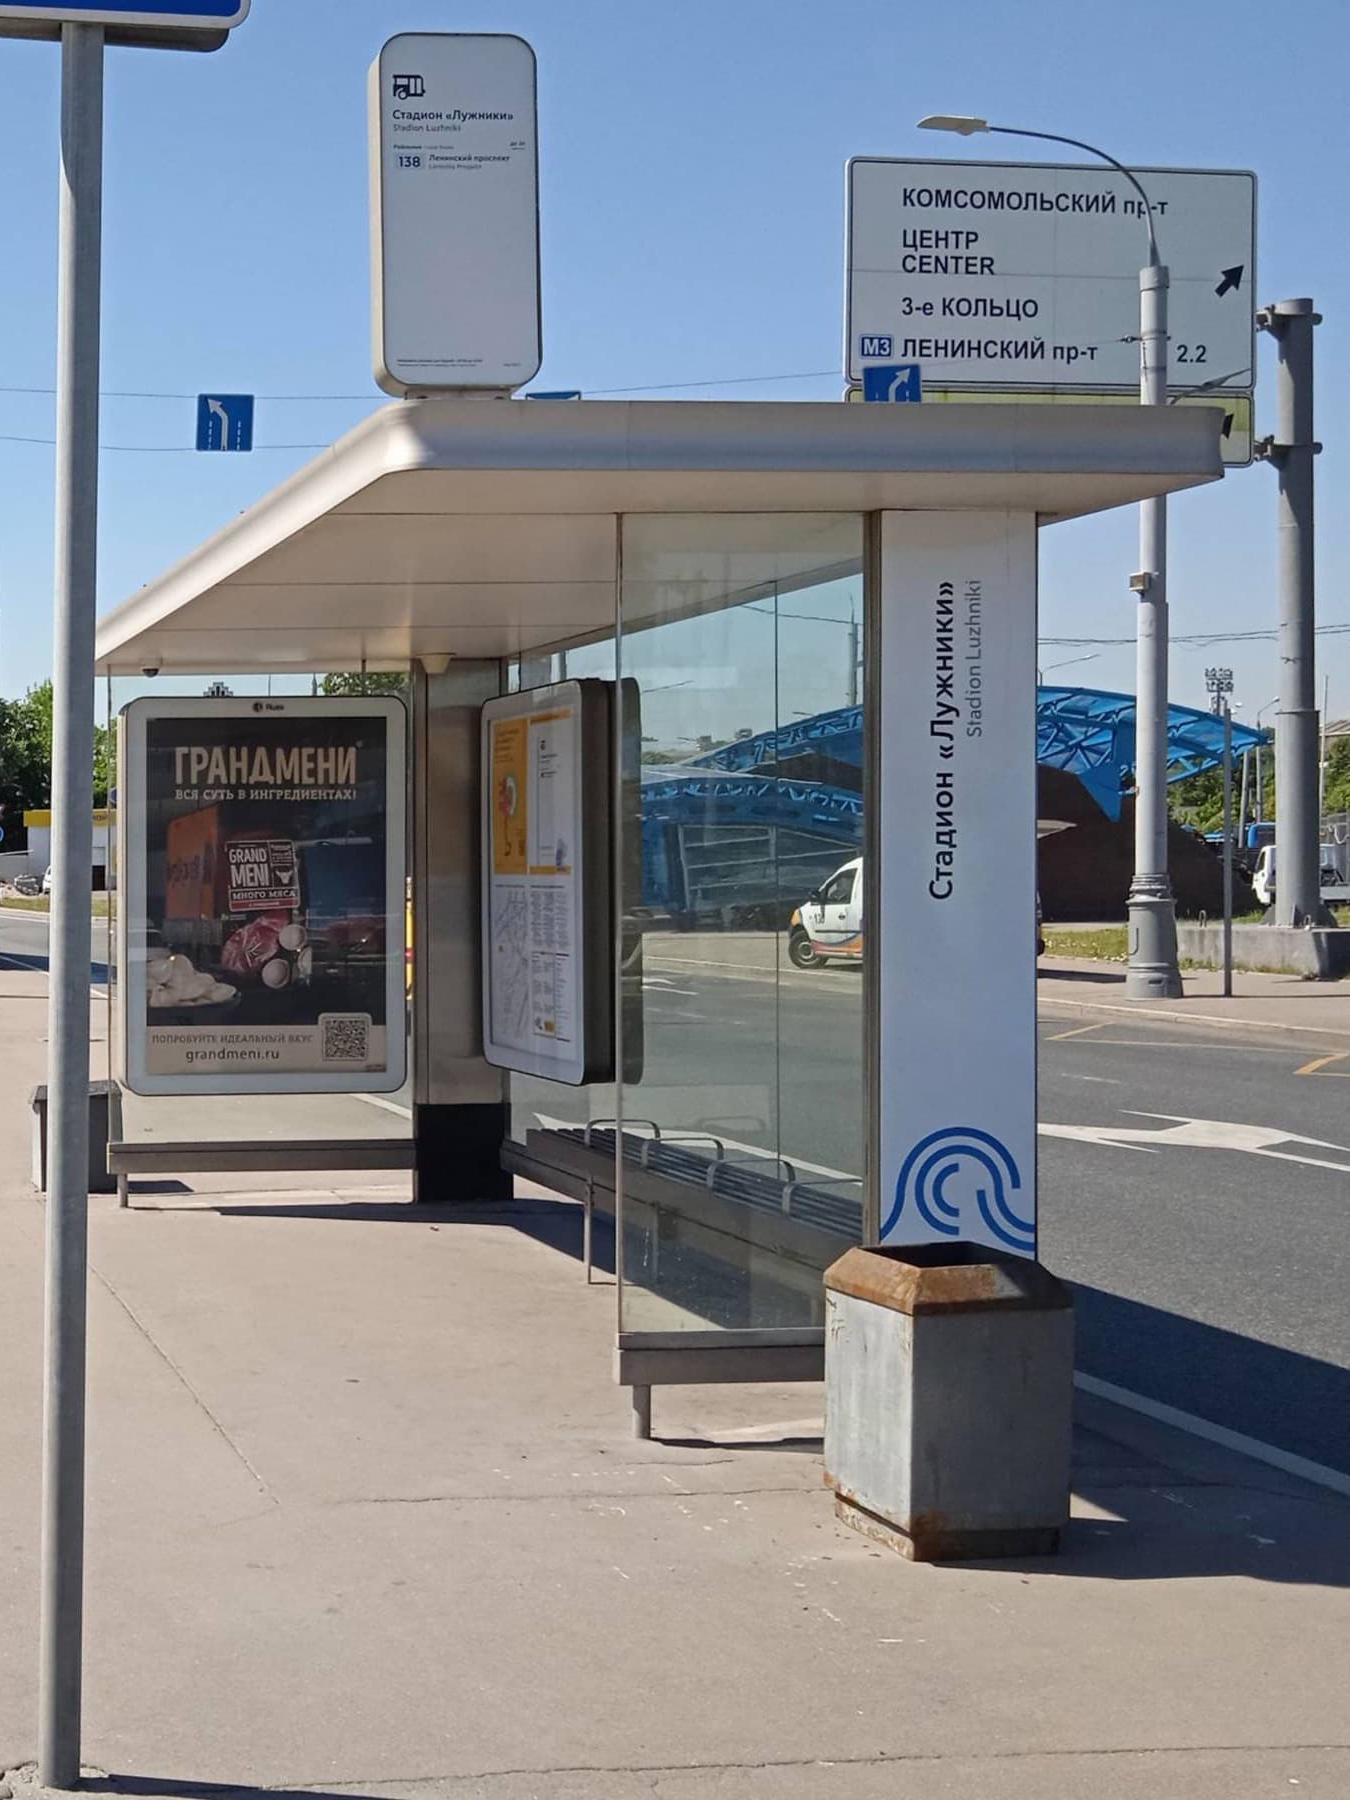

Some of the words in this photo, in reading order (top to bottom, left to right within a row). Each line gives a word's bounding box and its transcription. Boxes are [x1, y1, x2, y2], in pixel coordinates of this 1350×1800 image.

[392, 109, 443, 121] Стадион
[446, 109, 514, 123] «Лужники»
[398, 156, 421, 168] 138
[902, 187, 1117, 214] КОМСОМОЛЬСКИЙ
[902, 228, 979, 252] ЦЕНТР
[901, 253, 996, 276] CENTER
[901, 296, 935, 316] 3-е
[941, 297, 1040, 322] КОЛЬЦО
[862, 337, 891, 356] М3
[901, 335, 1046, 360] ЛЕНИНСКИЙ
[1052, 345, 1099, 365] пр-т
[1176, 343, 1208, 363] 2.2
[963, 579, 983, 660] Luzhniki
[930, 581, 960, 761] «Лужники»
[966, 665, 983, 738] Stadion
[175, 746, 357, 785] ГРАНДМЕНИ
[175, 789, 199, 800] ВСЯ
[203, 789, 234, 800] СУТЬ
[238, 789, 246, 800] В
[250, 789, 357, 802] ИНГРЕДИЕНТАХ!
[929, 771, 957, 901] Стадион
[229, 848, 267, 863] GRAND
[230, 863, 270, 888] MENI
[232, 891, 266, 900] МНОГО
[152, 1033, 218, 1044] ПОПРОБУЙТЕ
[185, 1048, 280, 1063] grandmeni.ru
